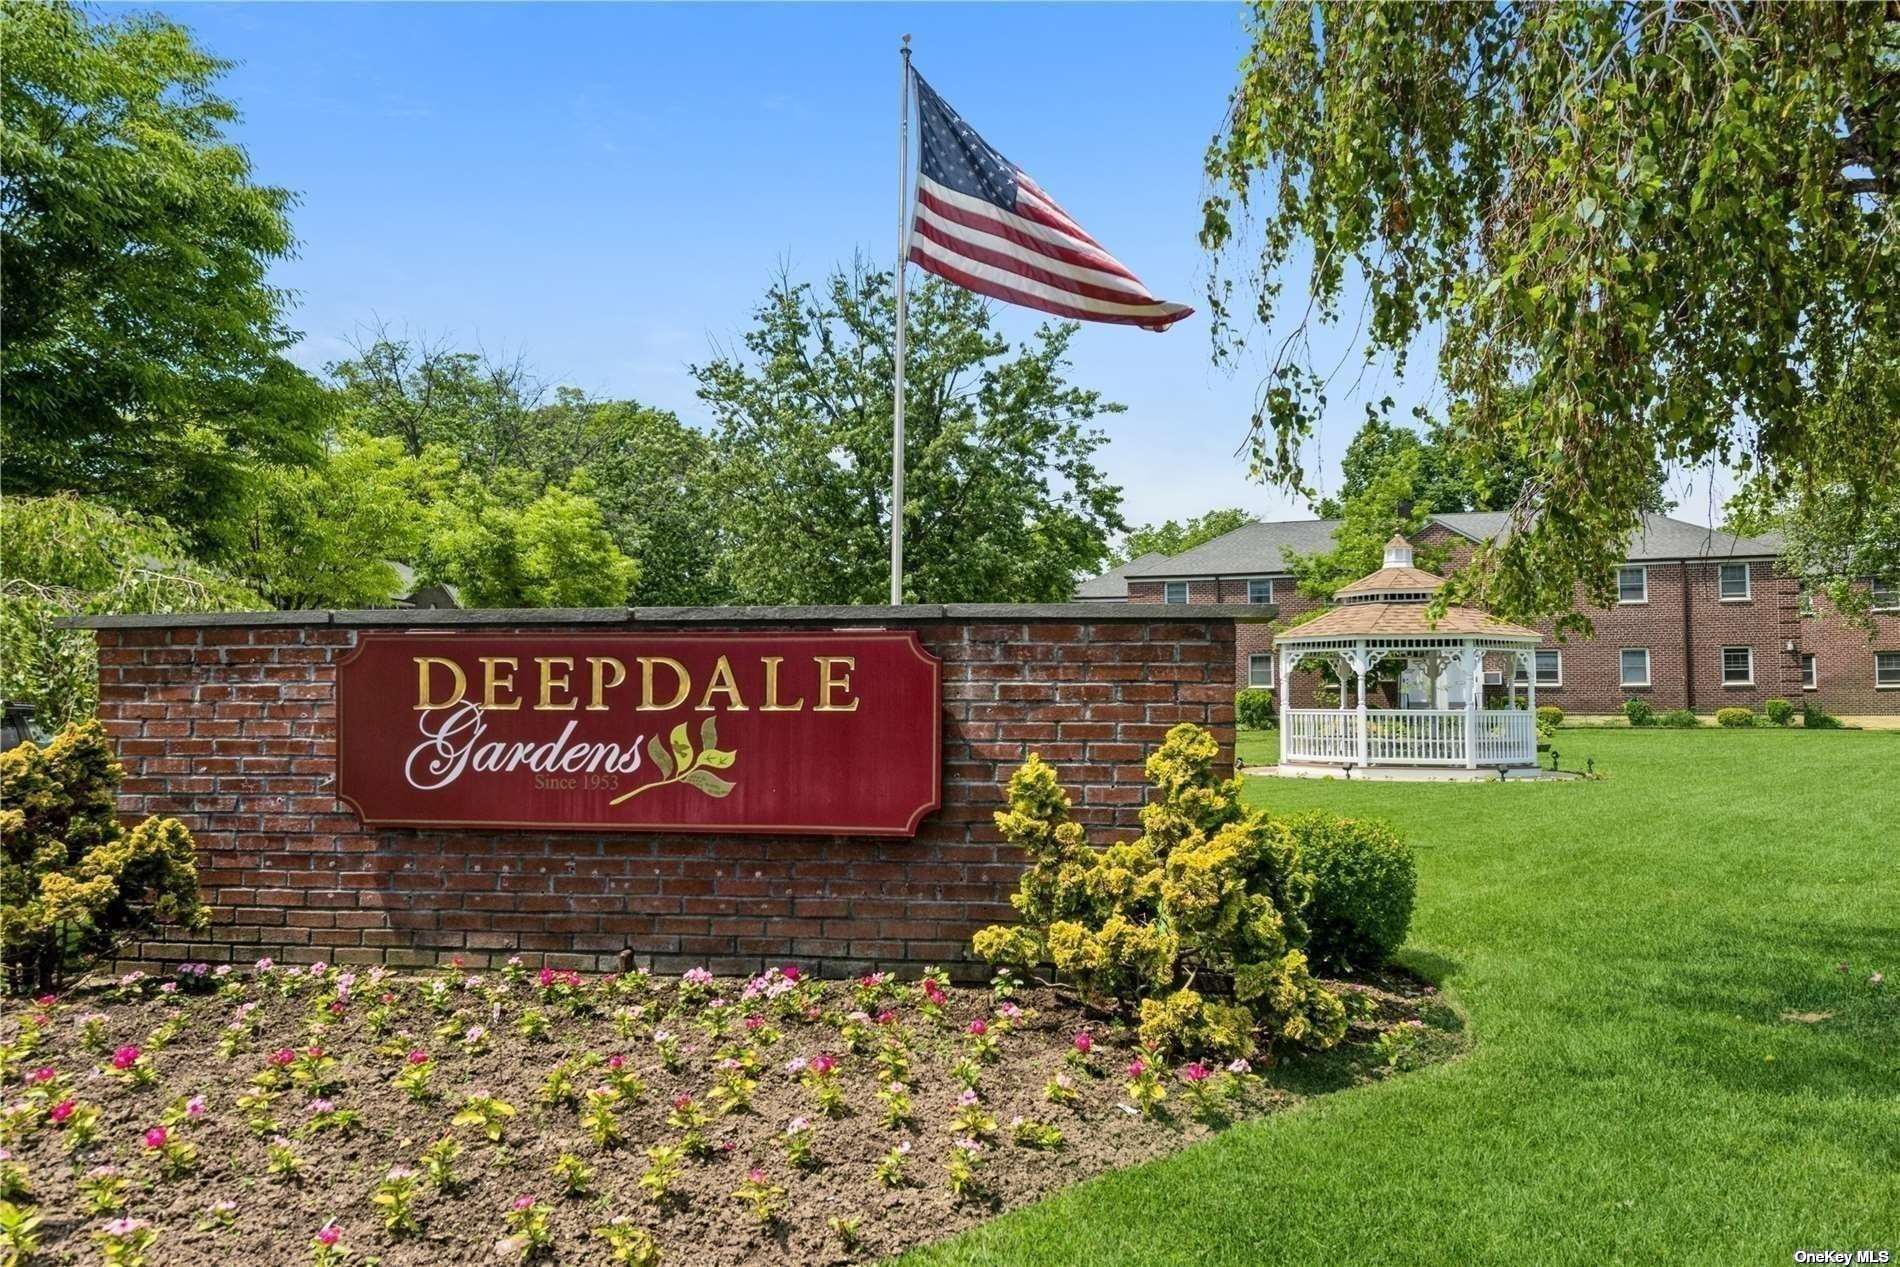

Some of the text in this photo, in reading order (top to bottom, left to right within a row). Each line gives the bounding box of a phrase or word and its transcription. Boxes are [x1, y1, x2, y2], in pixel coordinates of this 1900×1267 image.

[412, 654, 860, 712] DEEPDALE
[404, 699, 645, 790] Gardens
[534, 774, 619, 790] Since 1953
